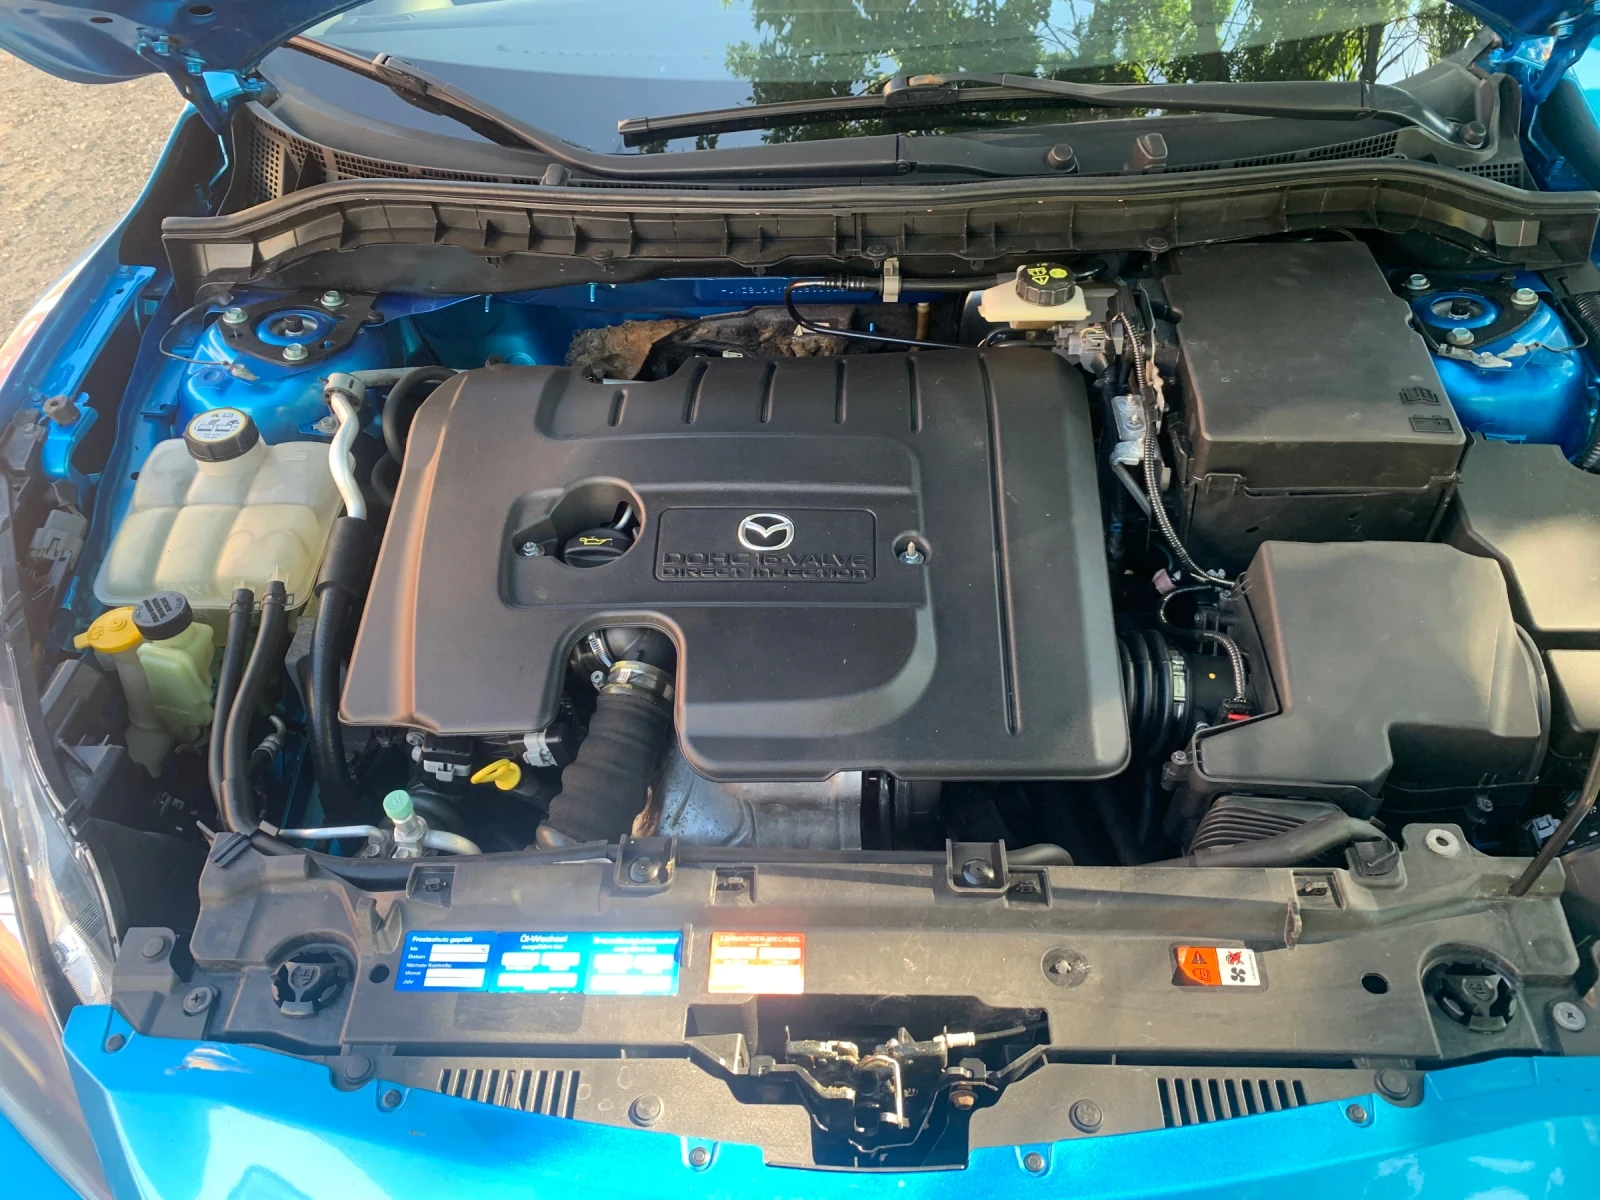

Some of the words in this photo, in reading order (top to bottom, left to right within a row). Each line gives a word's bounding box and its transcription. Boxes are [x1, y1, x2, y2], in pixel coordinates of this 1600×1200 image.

[662, 552, 749, 567] DOHC
[755, 552, 869, 567] 16-VALVE
[661, 567, 744, 578] DIRECT
